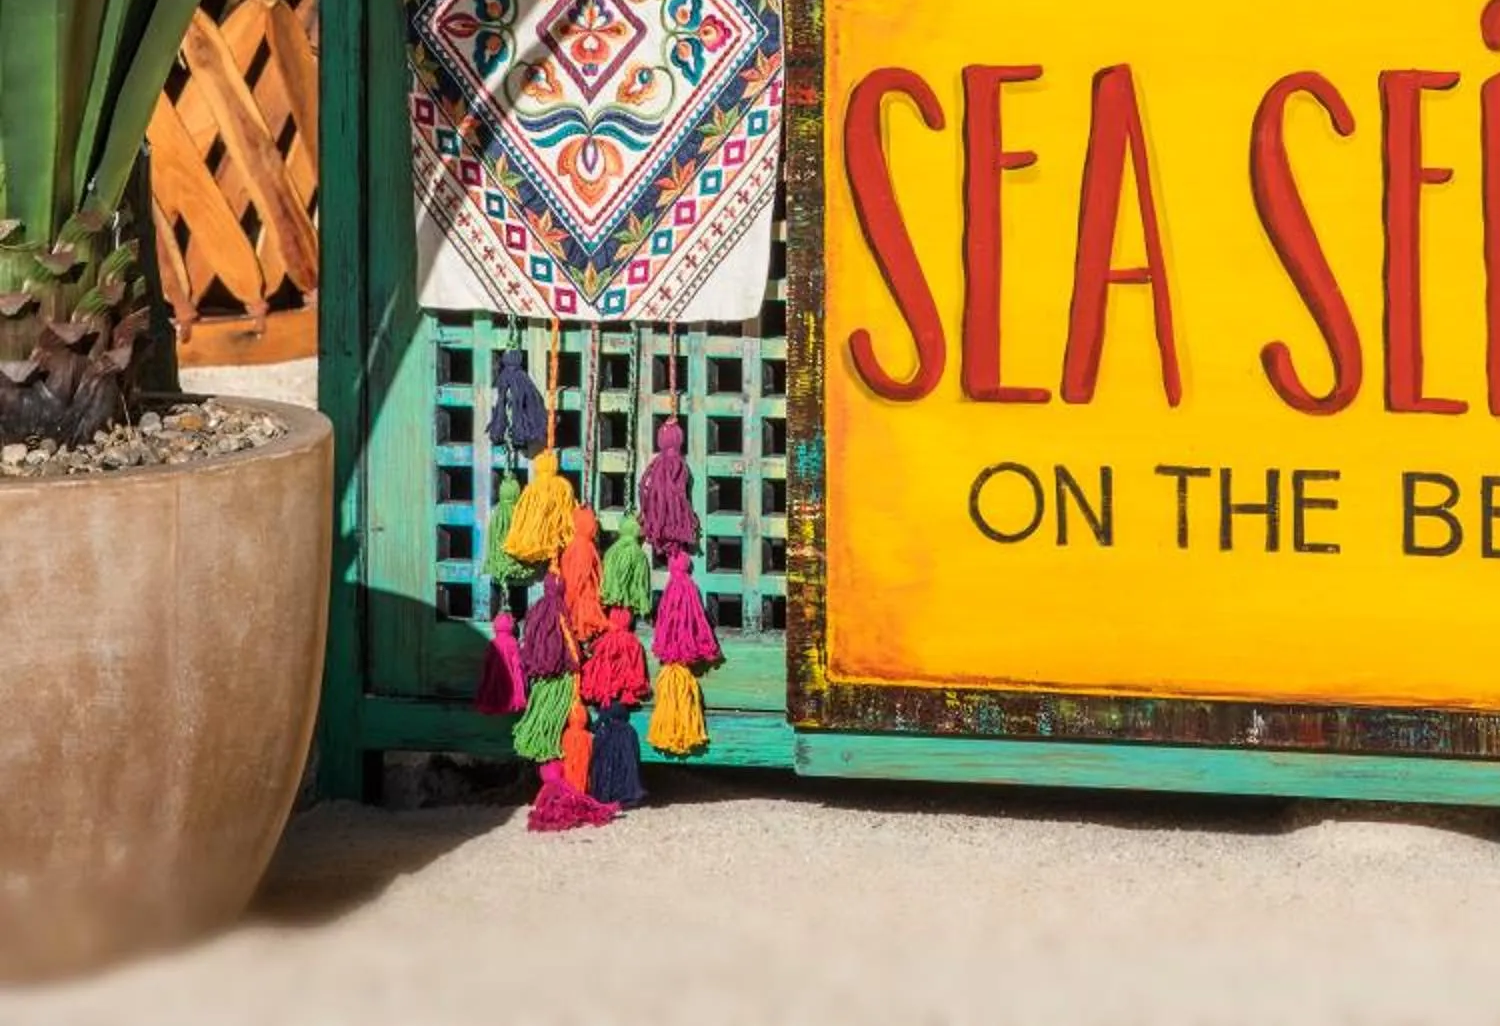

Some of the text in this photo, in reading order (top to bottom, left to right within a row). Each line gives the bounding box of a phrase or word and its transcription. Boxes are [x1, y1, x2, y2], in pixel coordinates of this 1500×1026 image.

[843, 63, 1182, 408] SEA
[968, 461, 1114, 547] ON
[1155, 464, 1341, 555] THE
